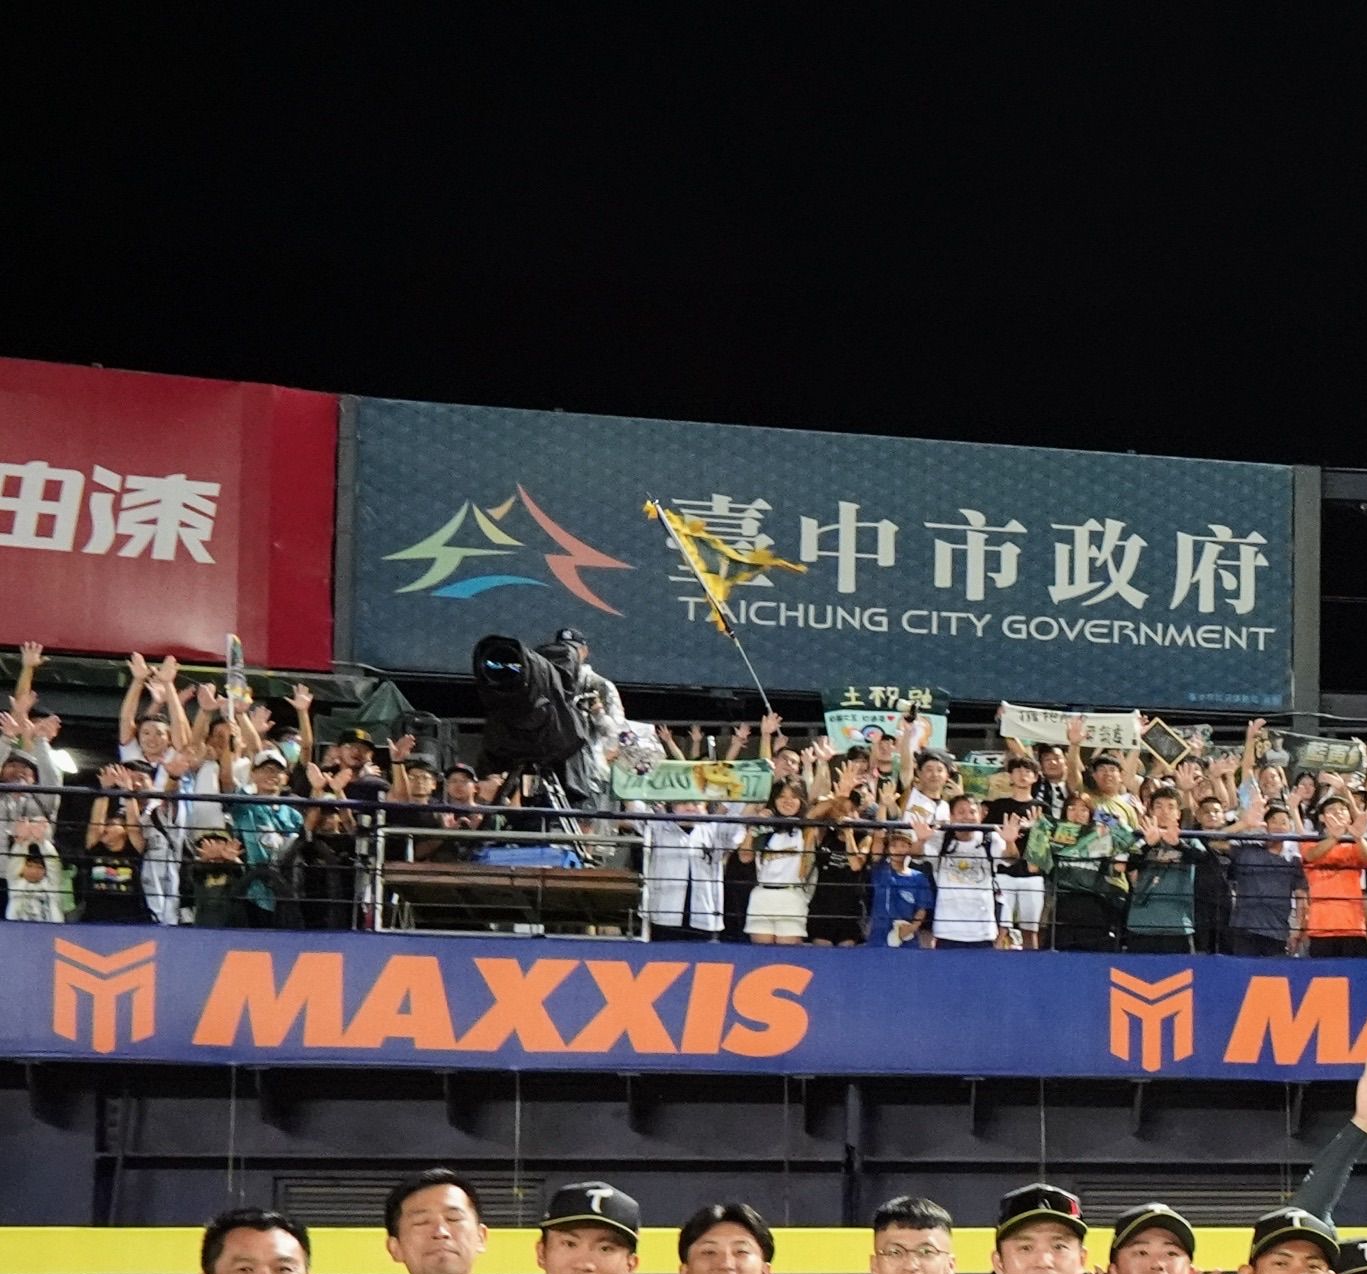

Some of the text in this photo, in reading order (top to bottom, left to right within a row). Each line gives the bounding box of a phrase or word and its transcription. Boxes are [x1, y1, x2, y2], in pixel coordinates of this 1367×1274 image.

[677, 596, 1276, 652] TAICHUNG CITY GOVERNMENT
[195, 953, 813, 1056] MAXXIS
